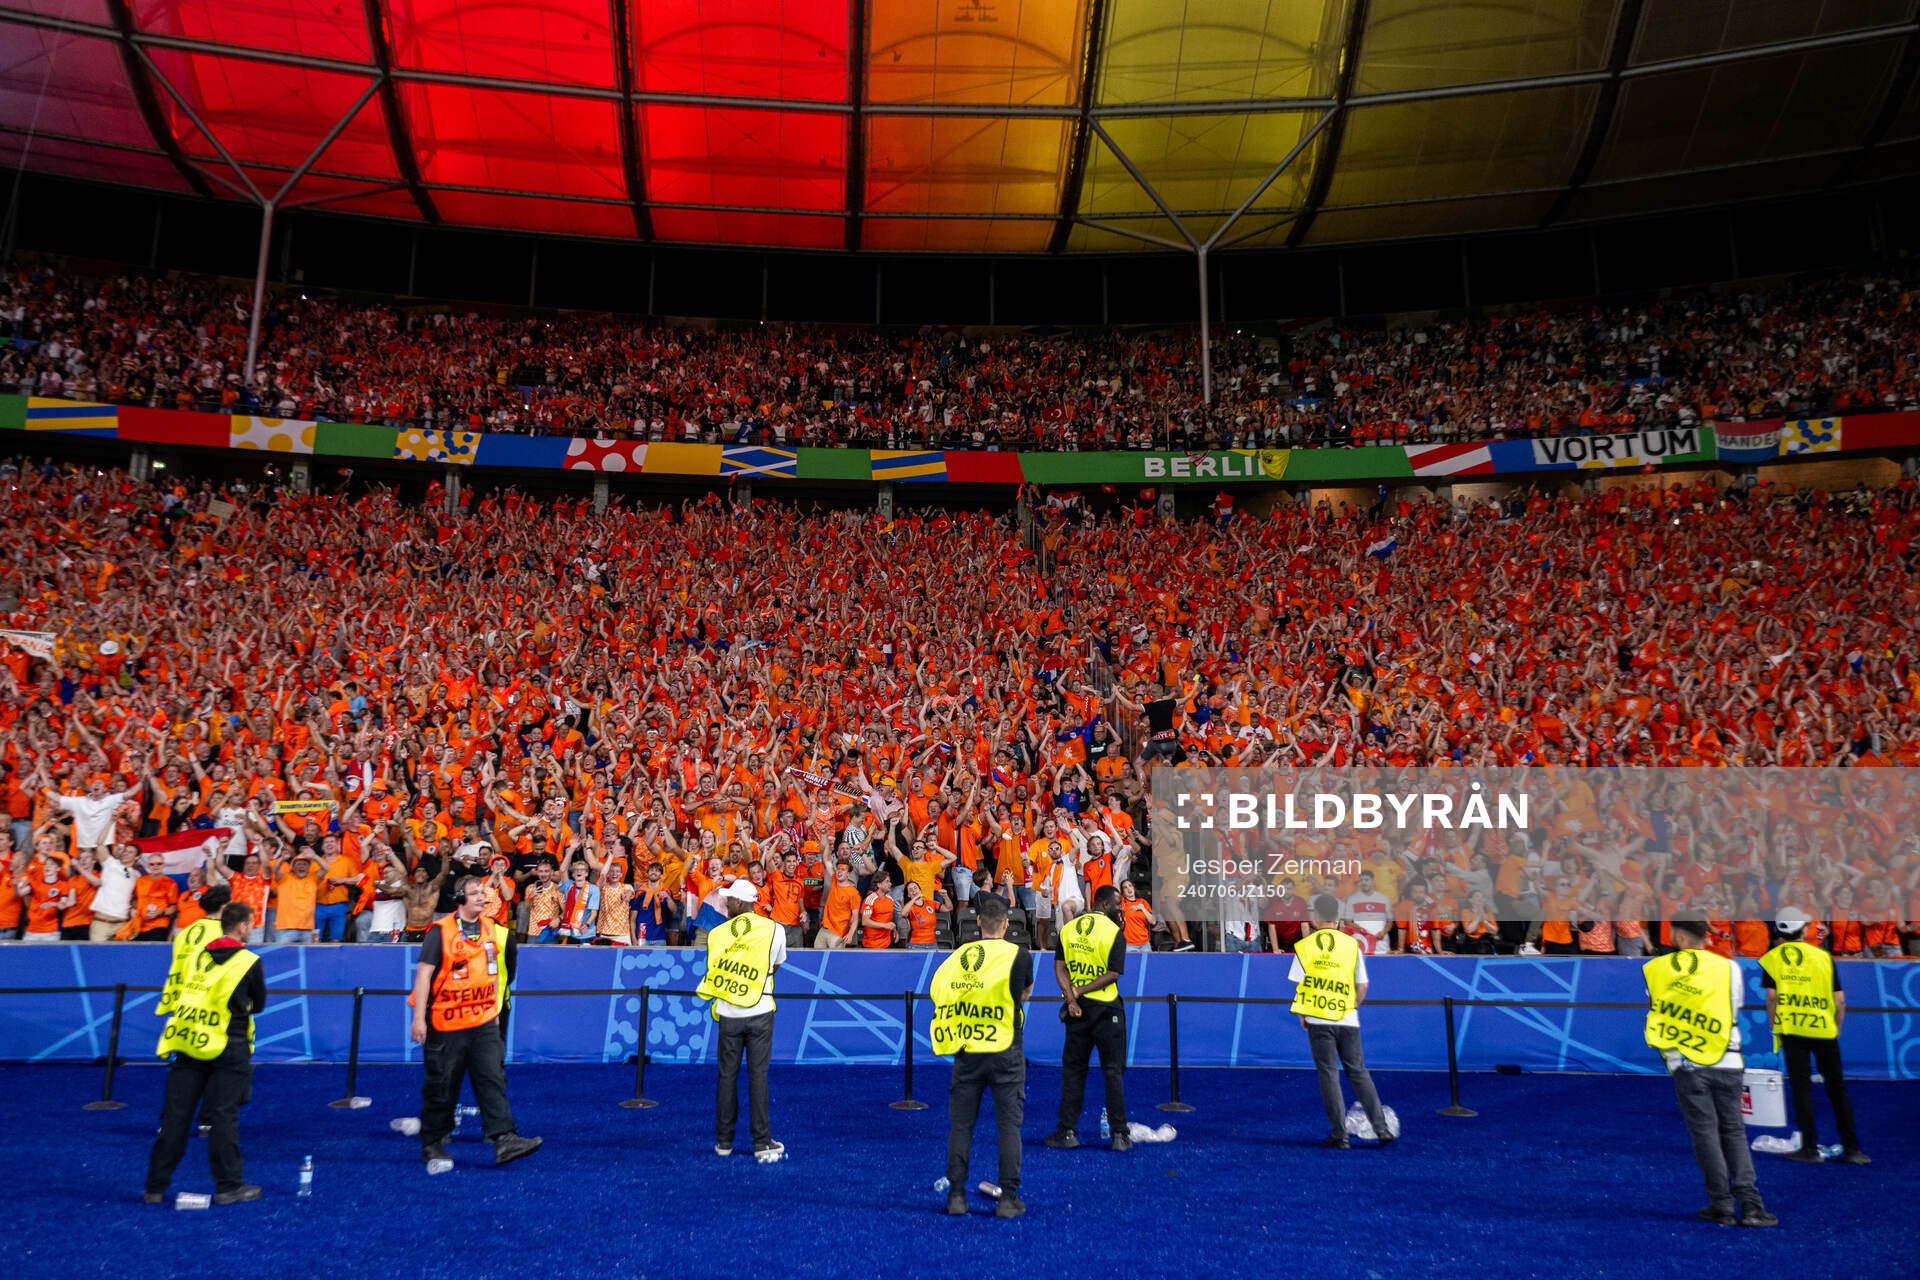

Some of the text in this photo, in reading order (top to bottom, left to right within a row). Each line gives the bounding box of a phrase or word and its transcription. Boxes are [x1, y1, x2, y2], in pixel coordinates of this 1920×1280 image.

[1538, 429, 1697, 463] VORTUM
[713, 958, 759, 981] WARD
[934, 1022, 997, 1043] 01-1052
